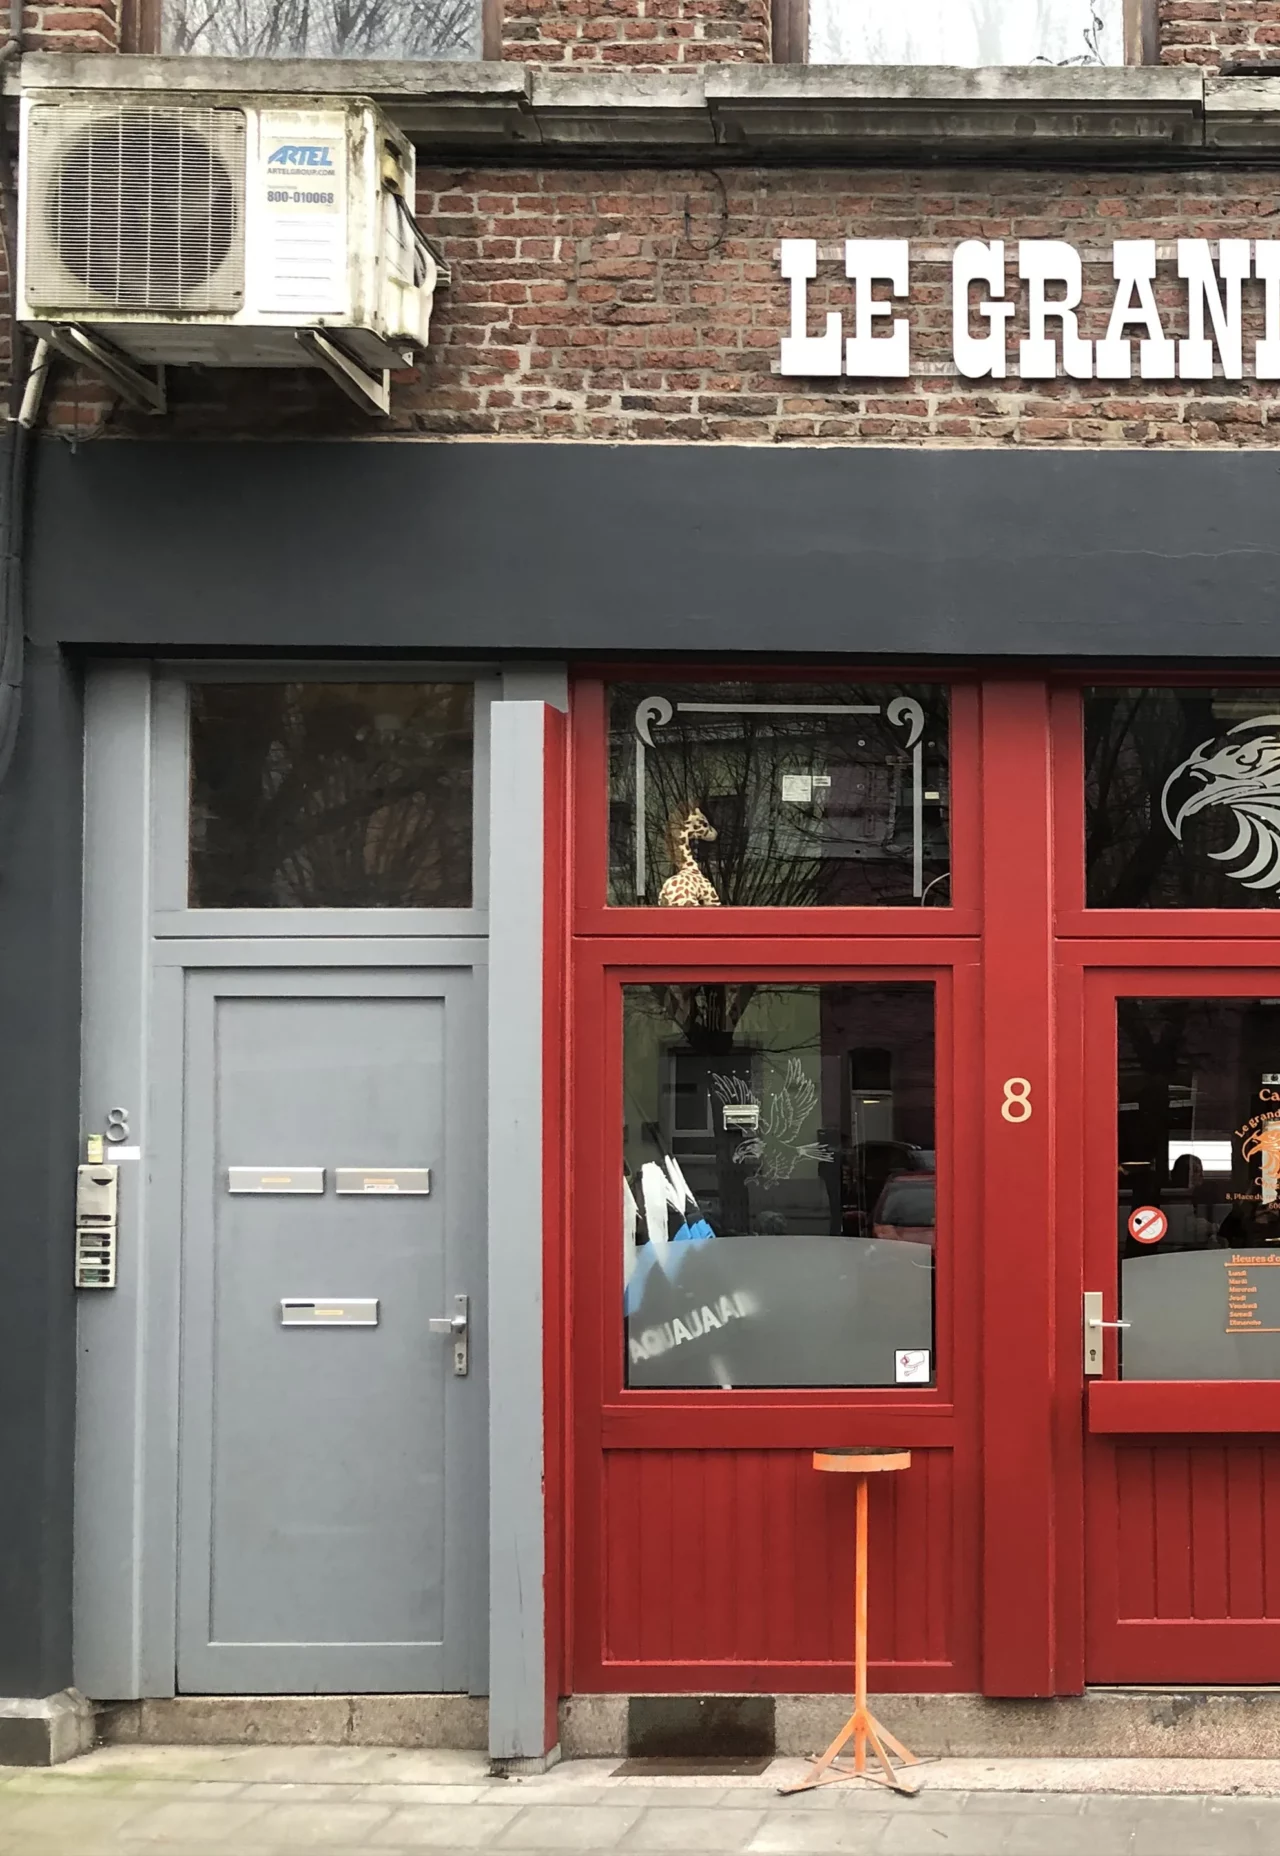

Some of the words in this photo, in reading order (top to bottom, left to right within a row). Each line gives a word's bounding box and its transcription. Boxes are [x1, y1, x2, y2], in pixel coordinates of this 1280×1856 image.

[267, 145, 333, 166] ARTEL
[267, 167, 336, 176] ARTELGROUP.COM
[267, 191, 334, 204] 800-010068
[780, 238, 910, 378] LE
[1001, 1077, 1032, 1123] 8
[106, 1107, 131, 1142] 8
[1234, 1124, 1249, 1138] Le
[1232, 1254, 1266, 1263] Heures
